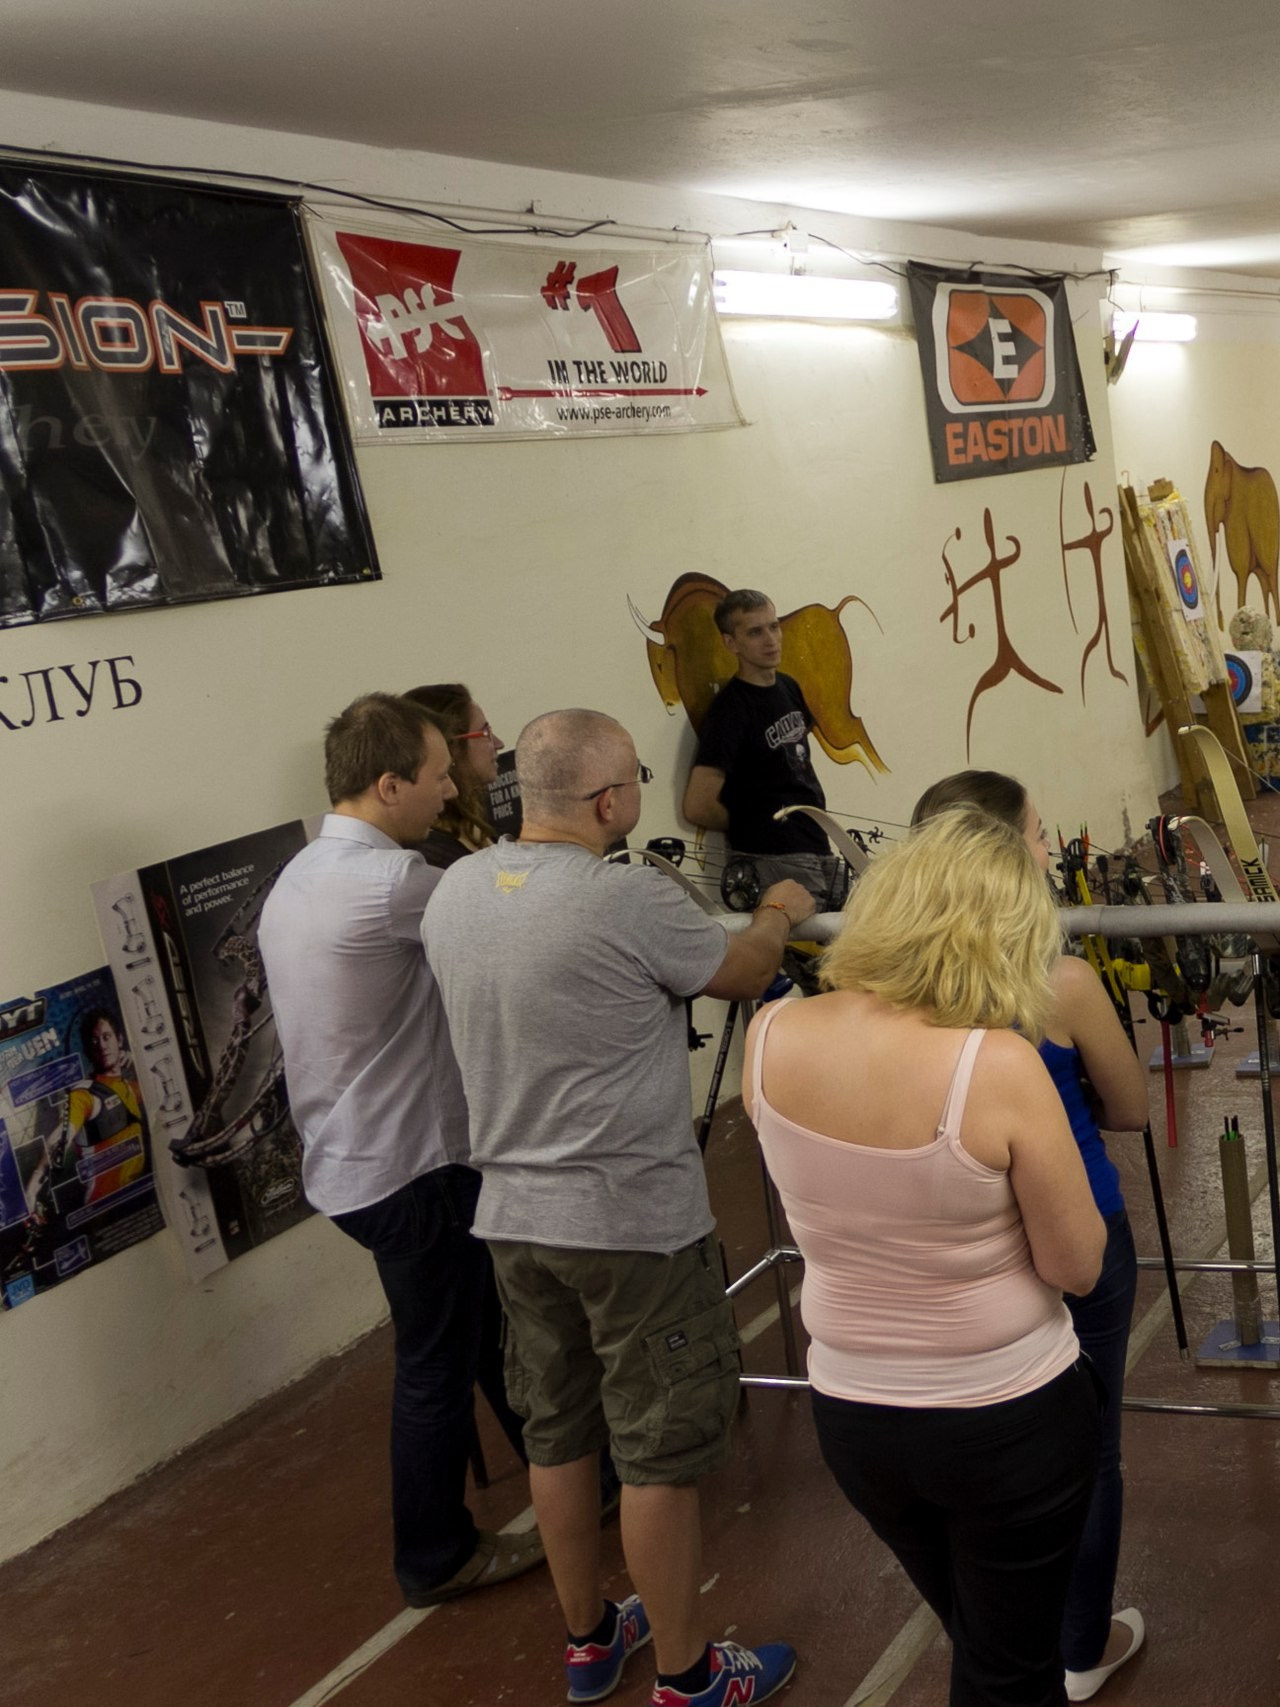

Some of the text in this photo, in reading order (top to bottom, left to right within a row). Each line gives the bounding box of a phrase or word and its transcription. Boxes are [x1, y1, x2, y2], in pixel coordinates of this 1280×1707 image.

[540, 260, 643, 354] #1
[988, 317, 1019, 379] E
[547, 360, 668, 384] IN THE WORLD
[381, 406, 490, 422] ARCHERY
[556, 402, 672, 425] www.pse-archery.com
[945, 414, 1067, 465] EASTON
[493, 801, 514, 820] PRICE
[180, 864, 255, 895] A perfect balance
[182, 877, 250, 906] of performance
[185, 894, 234, 917] and power.
[0, 1000, 43, 1030] YT
[623, 1615, 640, 1650] N
[721, 1675, 756, 1707] N
